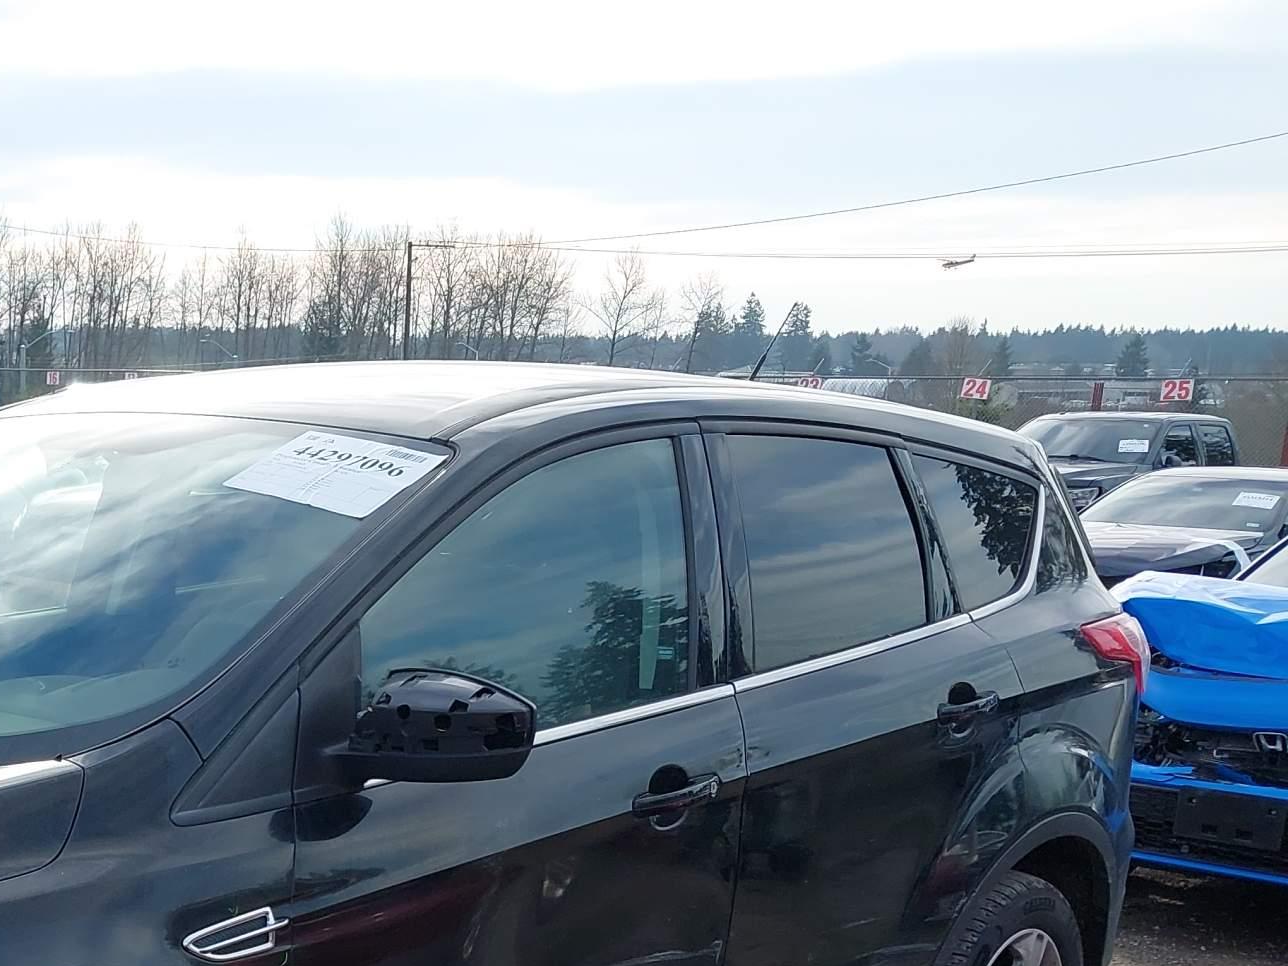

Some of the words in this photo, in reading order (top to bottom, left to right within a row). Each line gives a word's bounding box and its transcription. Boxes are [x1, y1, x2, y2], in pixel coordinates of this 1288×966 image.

[963, 379, 988, 398] 24
[1163, 380, 1191, 399] 25
[292, 446, 404, 477] 44297096
